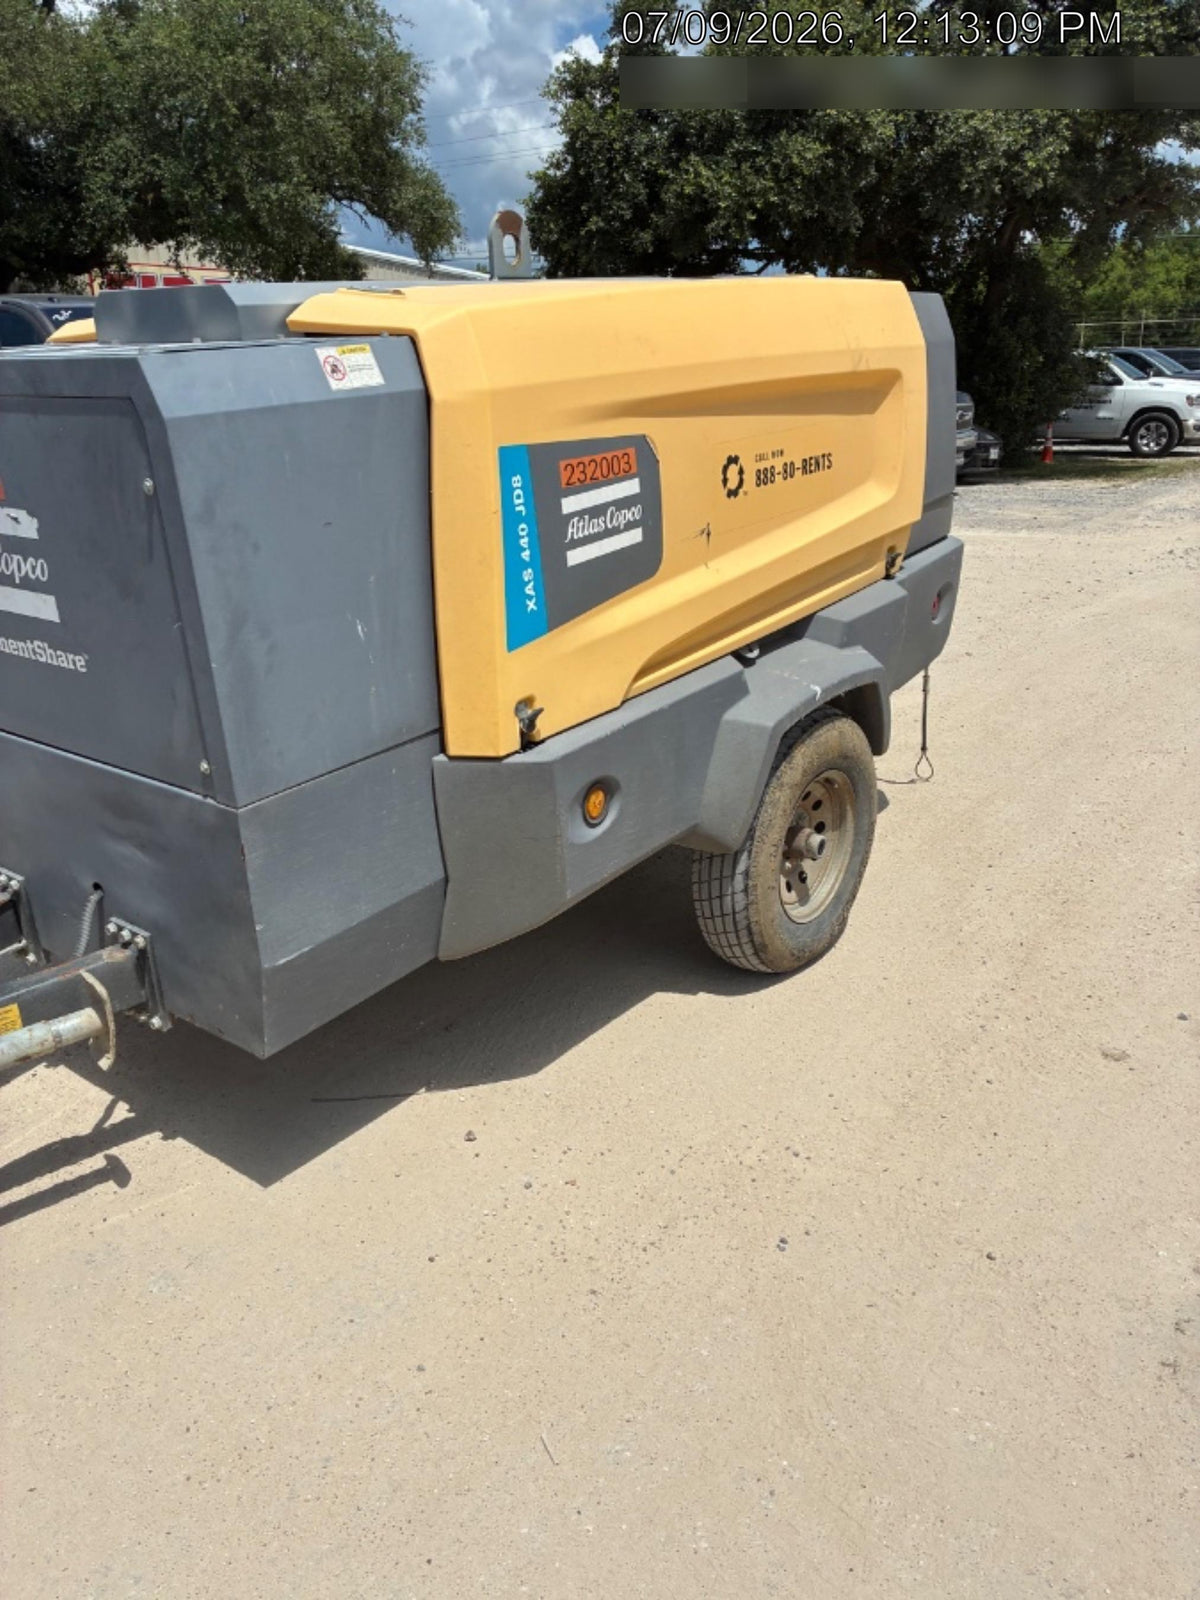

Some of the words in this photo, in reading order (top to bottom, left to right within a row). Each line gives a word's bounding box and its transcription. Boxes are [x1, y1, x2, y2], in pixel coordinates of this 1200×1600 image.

[563, 453, 632, 486] 232003
[755, 452, 833, 488] 888-80-RENTS
[511, 474, 526, 516] JD8
[517, 523, 531, 562] 440
[564, 514, 606, 543] Atlas
[606, 504, 643, 529] Copco
[0, 544, 49, 584] opco
[522, 567, 537, 614] XAS
